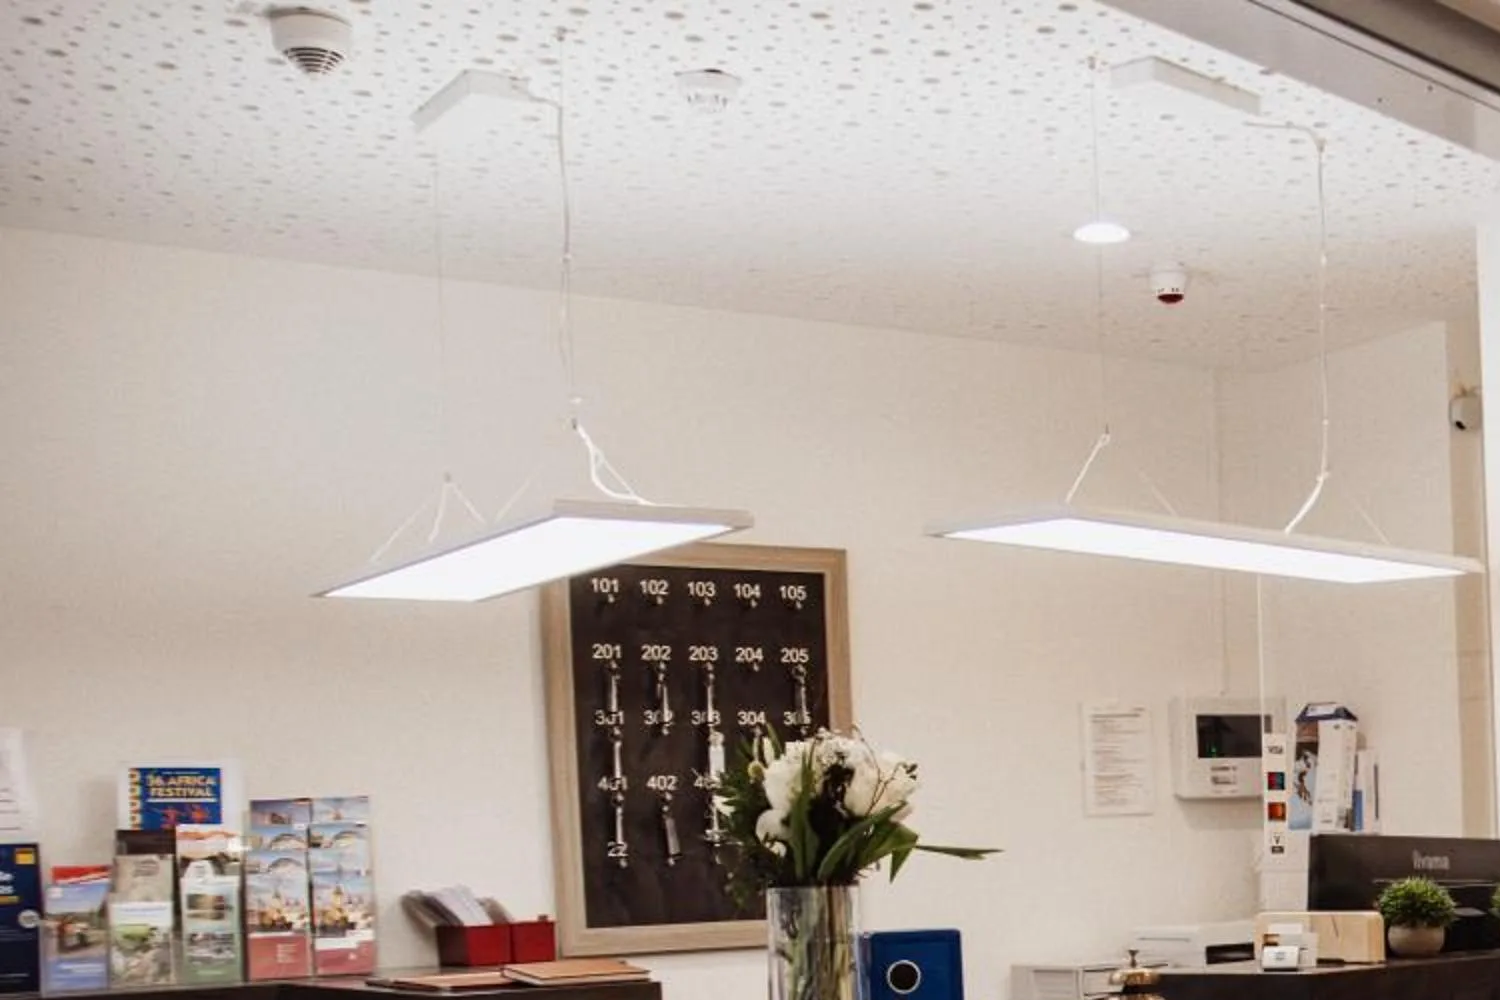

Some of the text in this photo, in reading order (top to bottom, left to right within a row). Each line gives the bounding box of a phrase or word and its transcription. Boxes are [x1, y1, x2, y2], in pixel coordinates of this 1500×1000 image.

[591, 577, 808, 601] 101 102 103 104 105
[592, 643, 810, 663] 201 202 203 204 205
[737, 710, 767, 725] 304
[168, 775, 218, 787] AFRICA
[646, 775, 678, 791] 402
[150, 786, 215, 798] FESTIVAL
